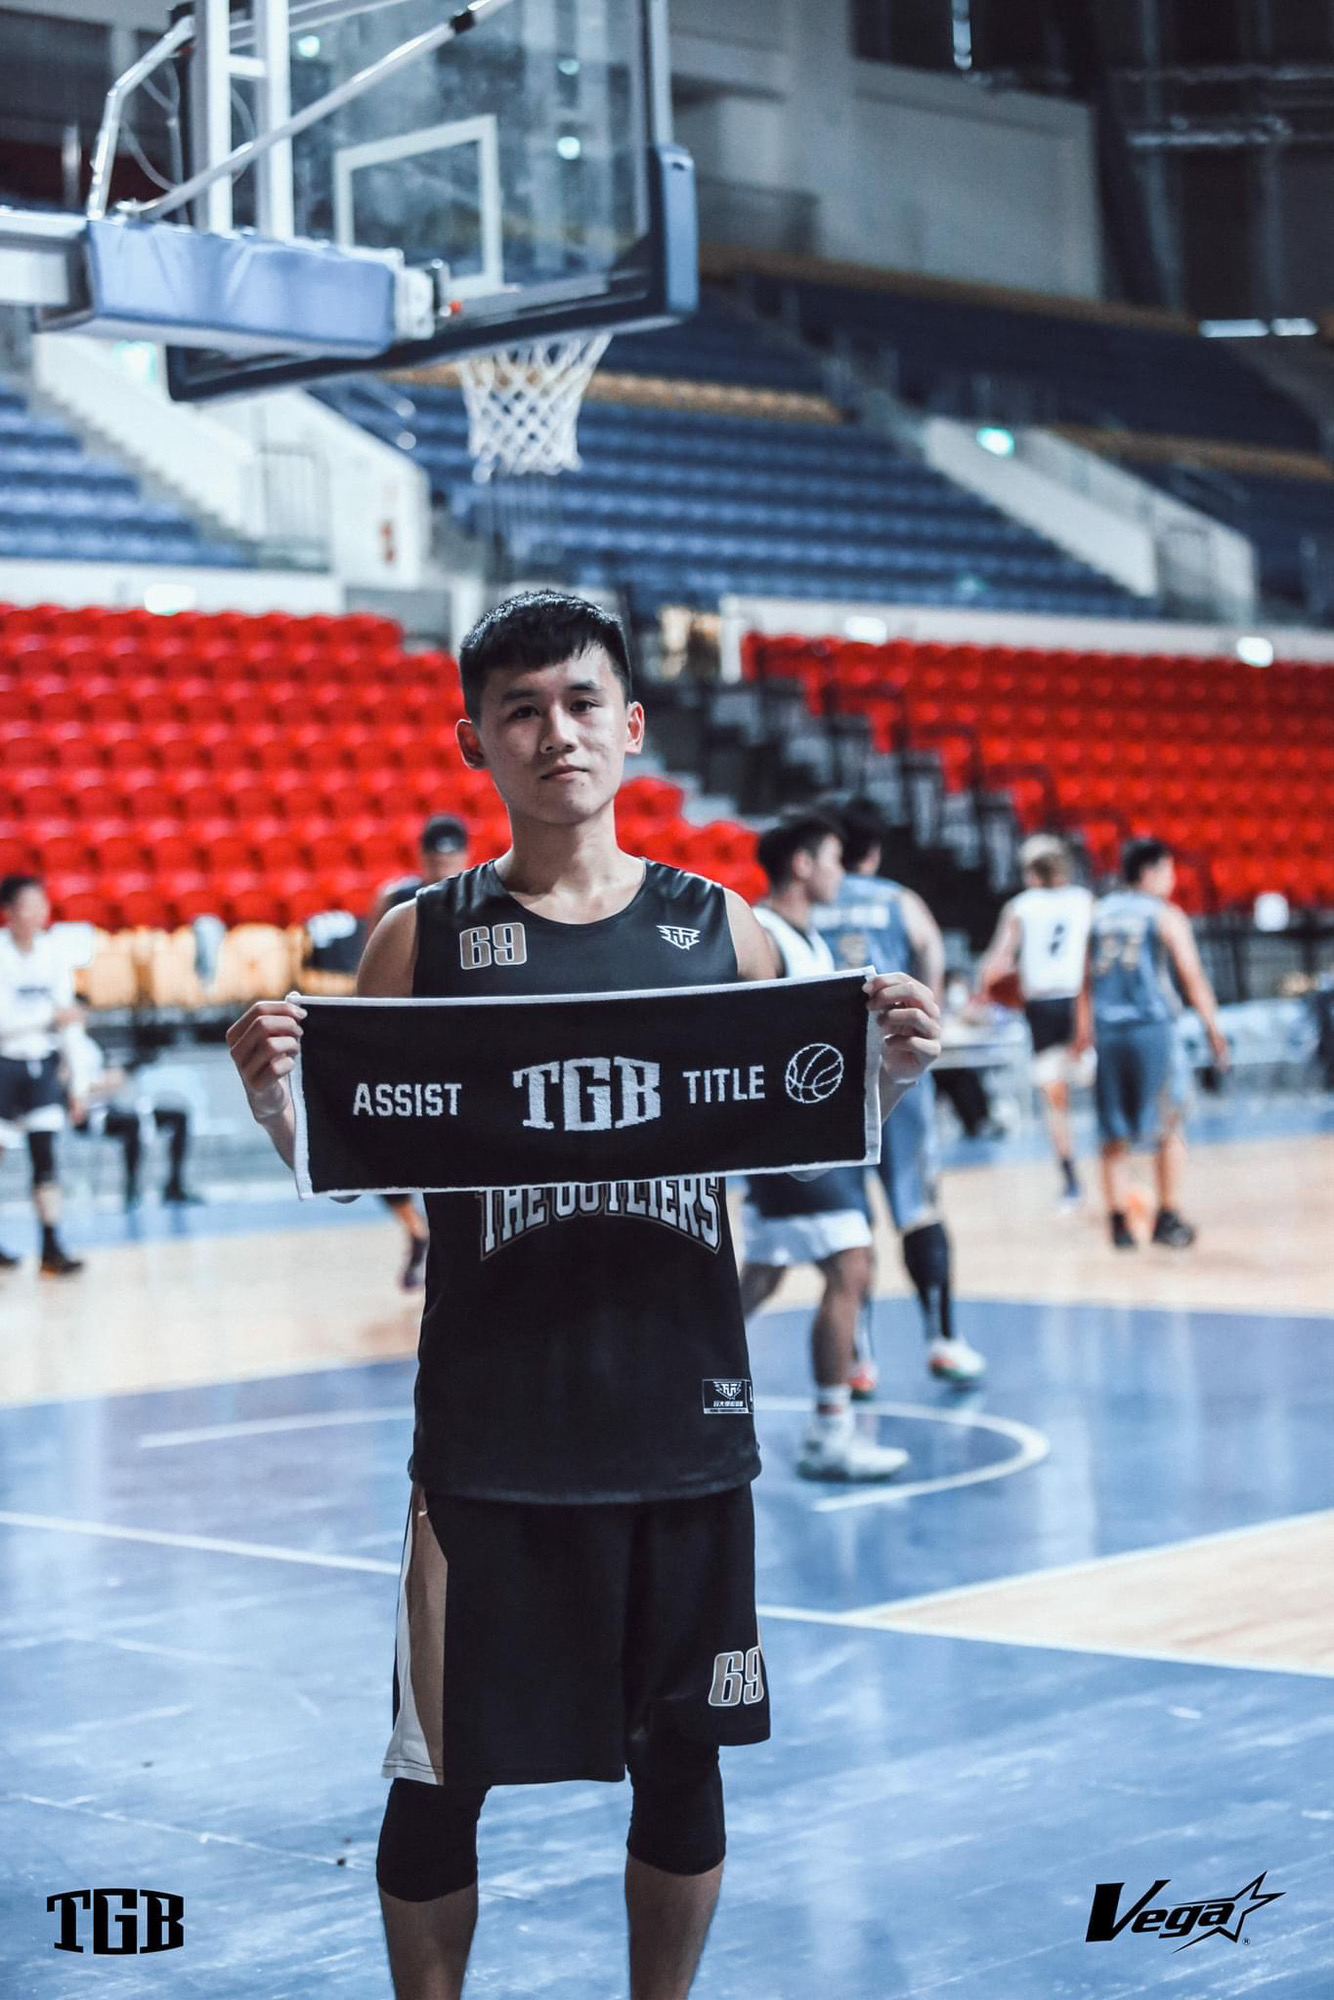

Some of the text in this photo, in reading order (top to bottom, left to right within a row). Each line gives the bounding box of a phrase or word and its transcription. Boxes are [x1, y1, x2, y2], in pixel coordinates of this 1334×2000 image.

[459, 922, 527, 970] 69
[353, 1056, 765, 1131] ASSIST TGB TITLE
[480, 1186, 549, 1260] THE
[708, 1645, 764, 1706] 69
